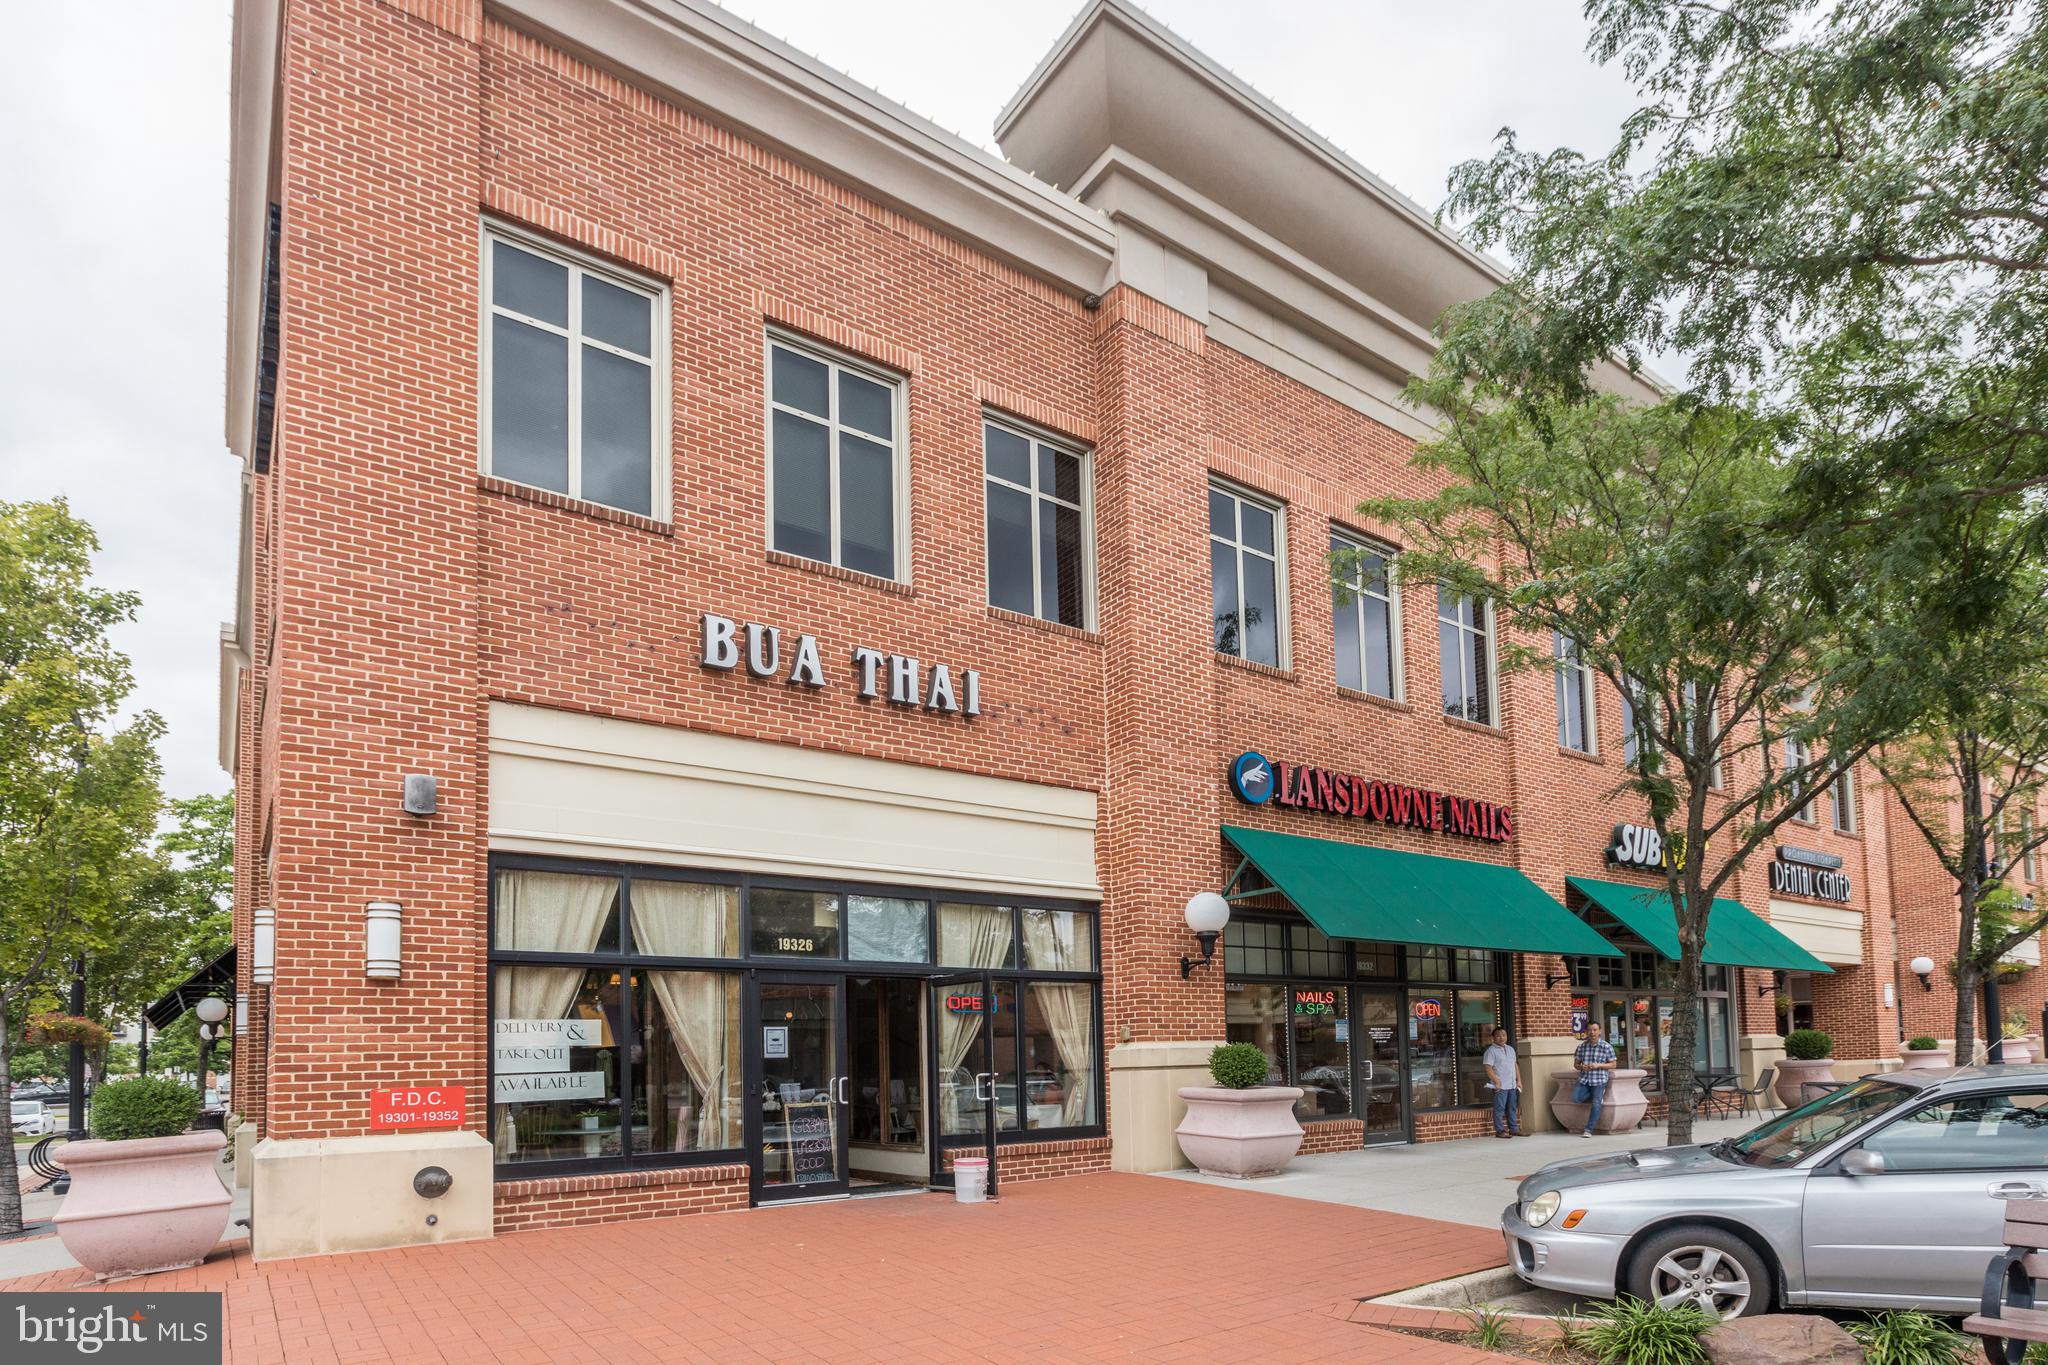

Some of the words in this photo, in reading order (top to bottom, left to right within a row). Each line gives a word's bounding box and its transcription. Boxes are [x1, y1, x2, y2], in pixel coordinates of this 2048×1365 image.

[701, 613, 826, 688] BUA
[851, 646, 981, 716] THAI
[1274, 760, 1442, 831] LANSDOWNE
[1449, 795, 1513, 842] NAILS
[1774, 861, 1816, 896] DENTAL
[1816, 870, 1851, 901] CENTER
[777, 937, 813, 952] 19326
[946, 996, 984, 1010] OPE
[1295, 992, 1334, 1004] NAILS
[1295, 1003, 1303, 1014] &
[1306, 1003, 1335, 1015] SPA
[1415, 1002, 1441, 1017] OPEN
[496, 1022, 564, 1034] DELIVERY
[566, 1024, 586, 1041] &
[496, 1075, 588, 1092] AVAILABLE
[391, 1091, 447, 1107] F.D.C.
[378, 1110, 459, 1124] 19301-19352
